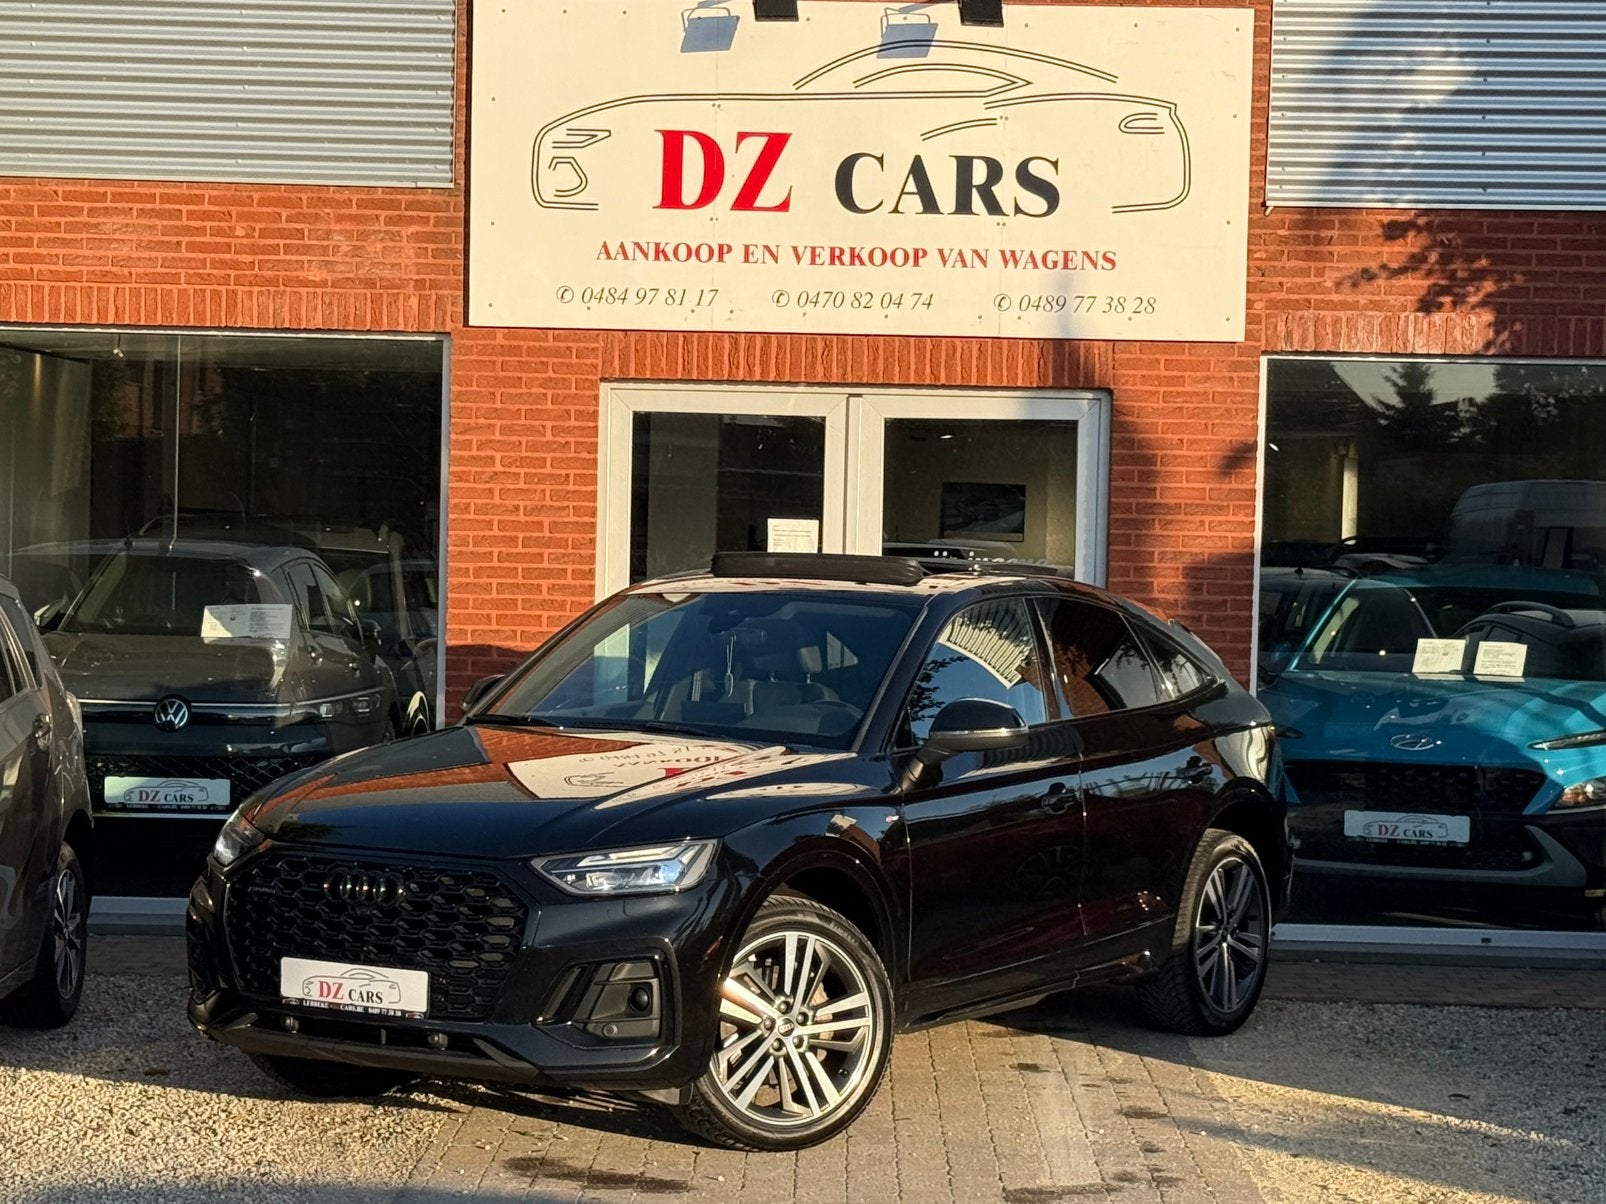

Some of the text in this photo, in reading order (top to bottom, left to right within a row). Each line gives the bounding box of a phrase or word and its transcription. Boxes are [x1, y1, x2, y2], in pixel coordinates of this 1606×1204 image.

[652, 129, 1061, 218] DZ CARS
[596, 240, 1117, 271] AANKOOP EN VERKOOP VAN WAGENS
[580, 287, 719, 307] 0484 97 81 17
[796, 291, 934, 310] 0470 82 04 74
[1018, 294, 1156, 314] 0489 77 38 28
[139, 790, 194, 803] DZ CARS
[1377, 824, 1433, 839] DZ CARS
[318, 980, 383, 1004] DZ CARS
